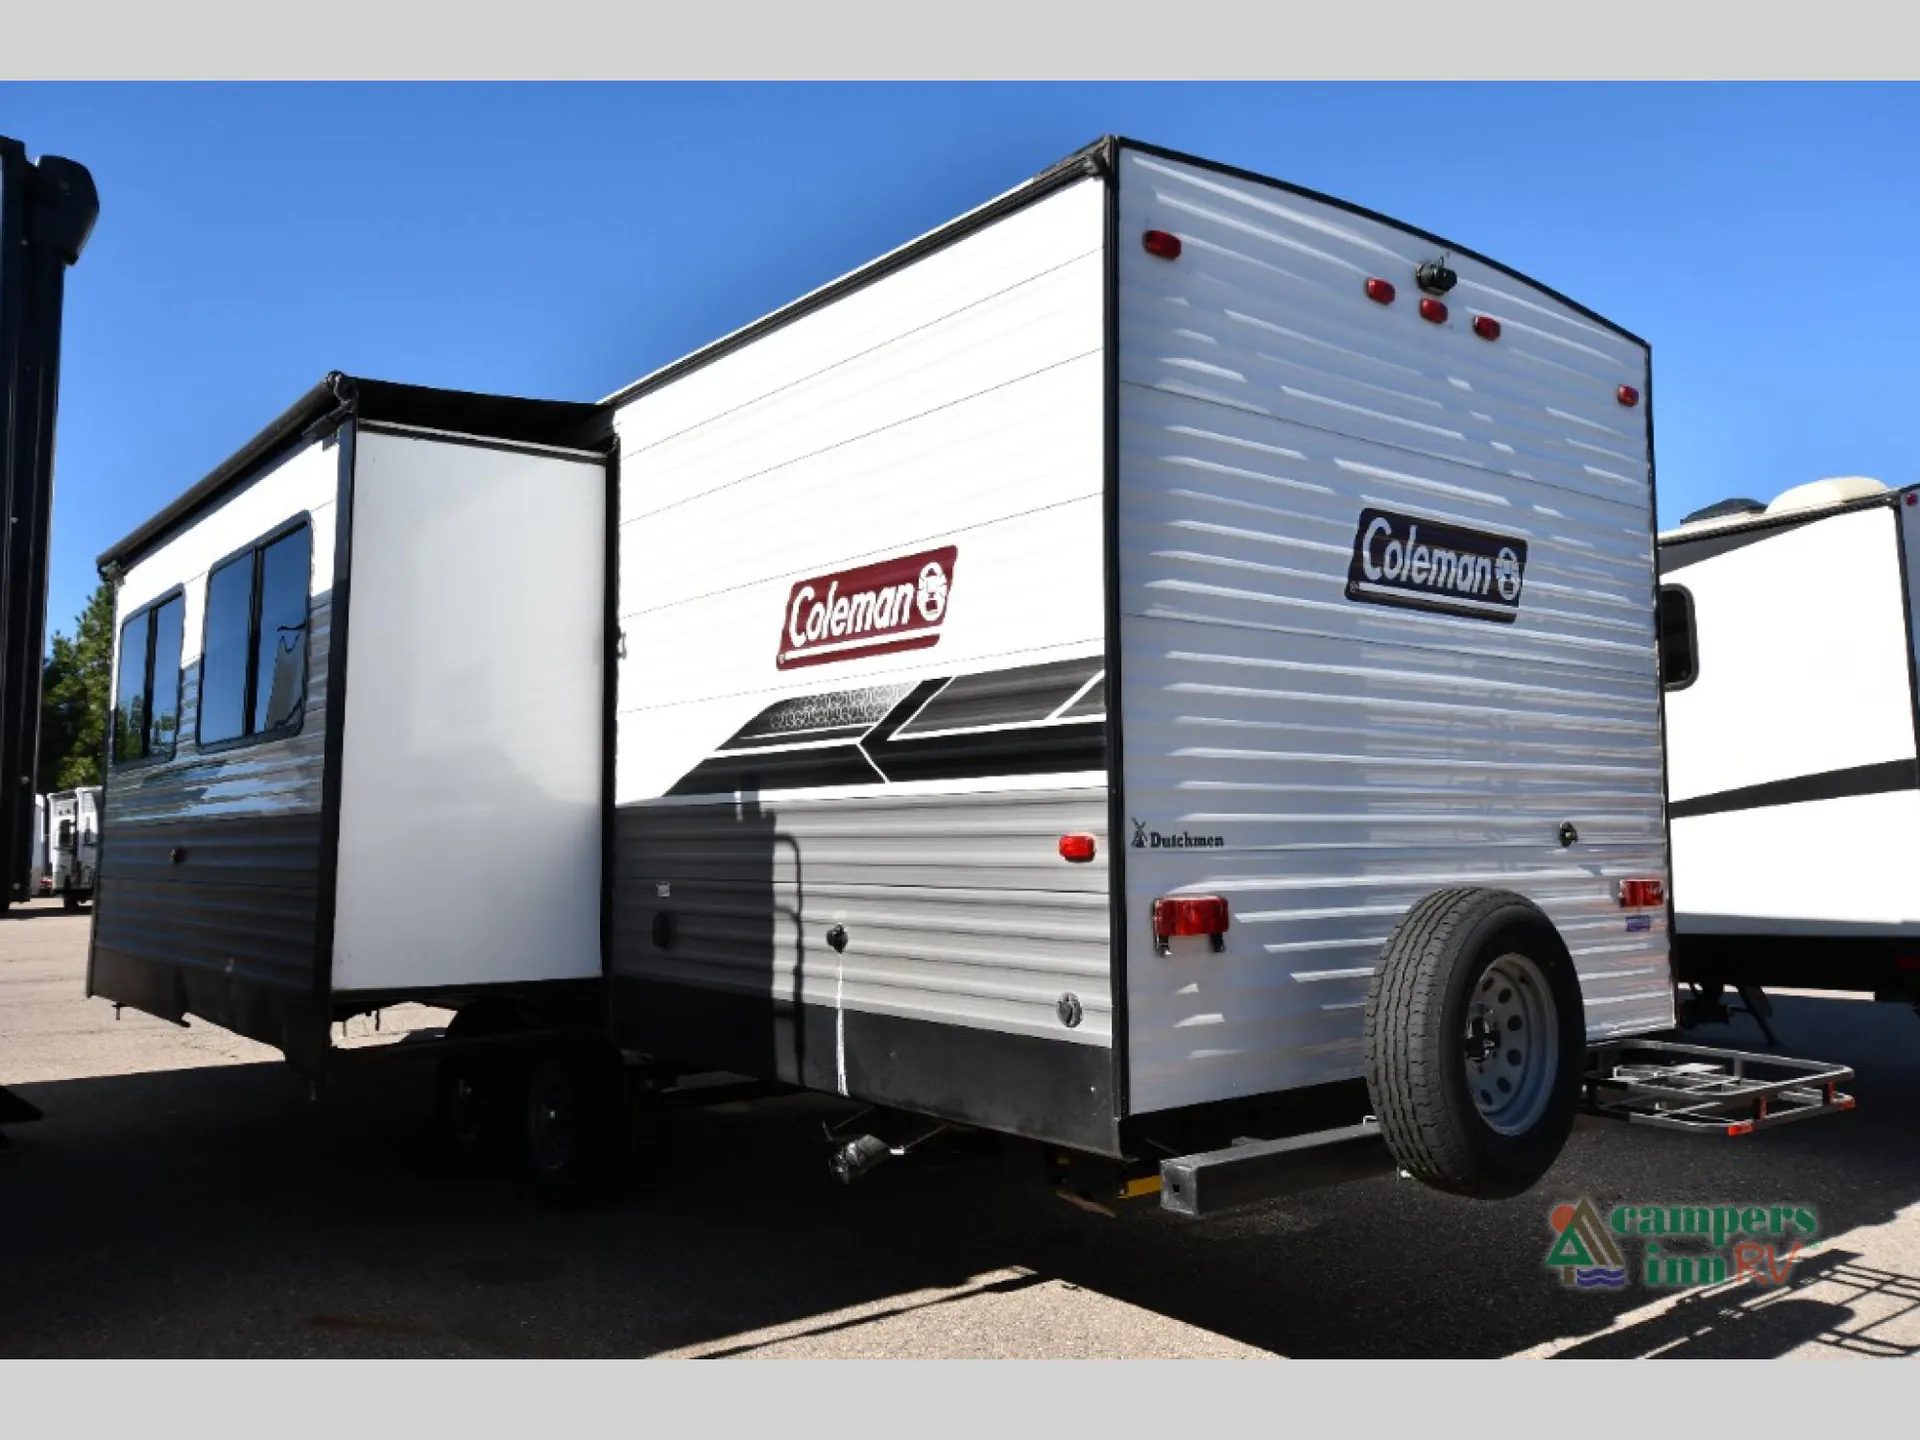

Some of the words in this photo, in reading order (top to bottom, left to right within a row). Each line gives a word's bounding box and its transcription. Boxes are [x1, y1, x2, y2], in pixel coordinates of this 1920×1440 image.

[1362, 516, 1492, 596] Coleman
[789, 580, 915, 648] Coleman
[1149, 831, 1225, 849] Dutchmen
